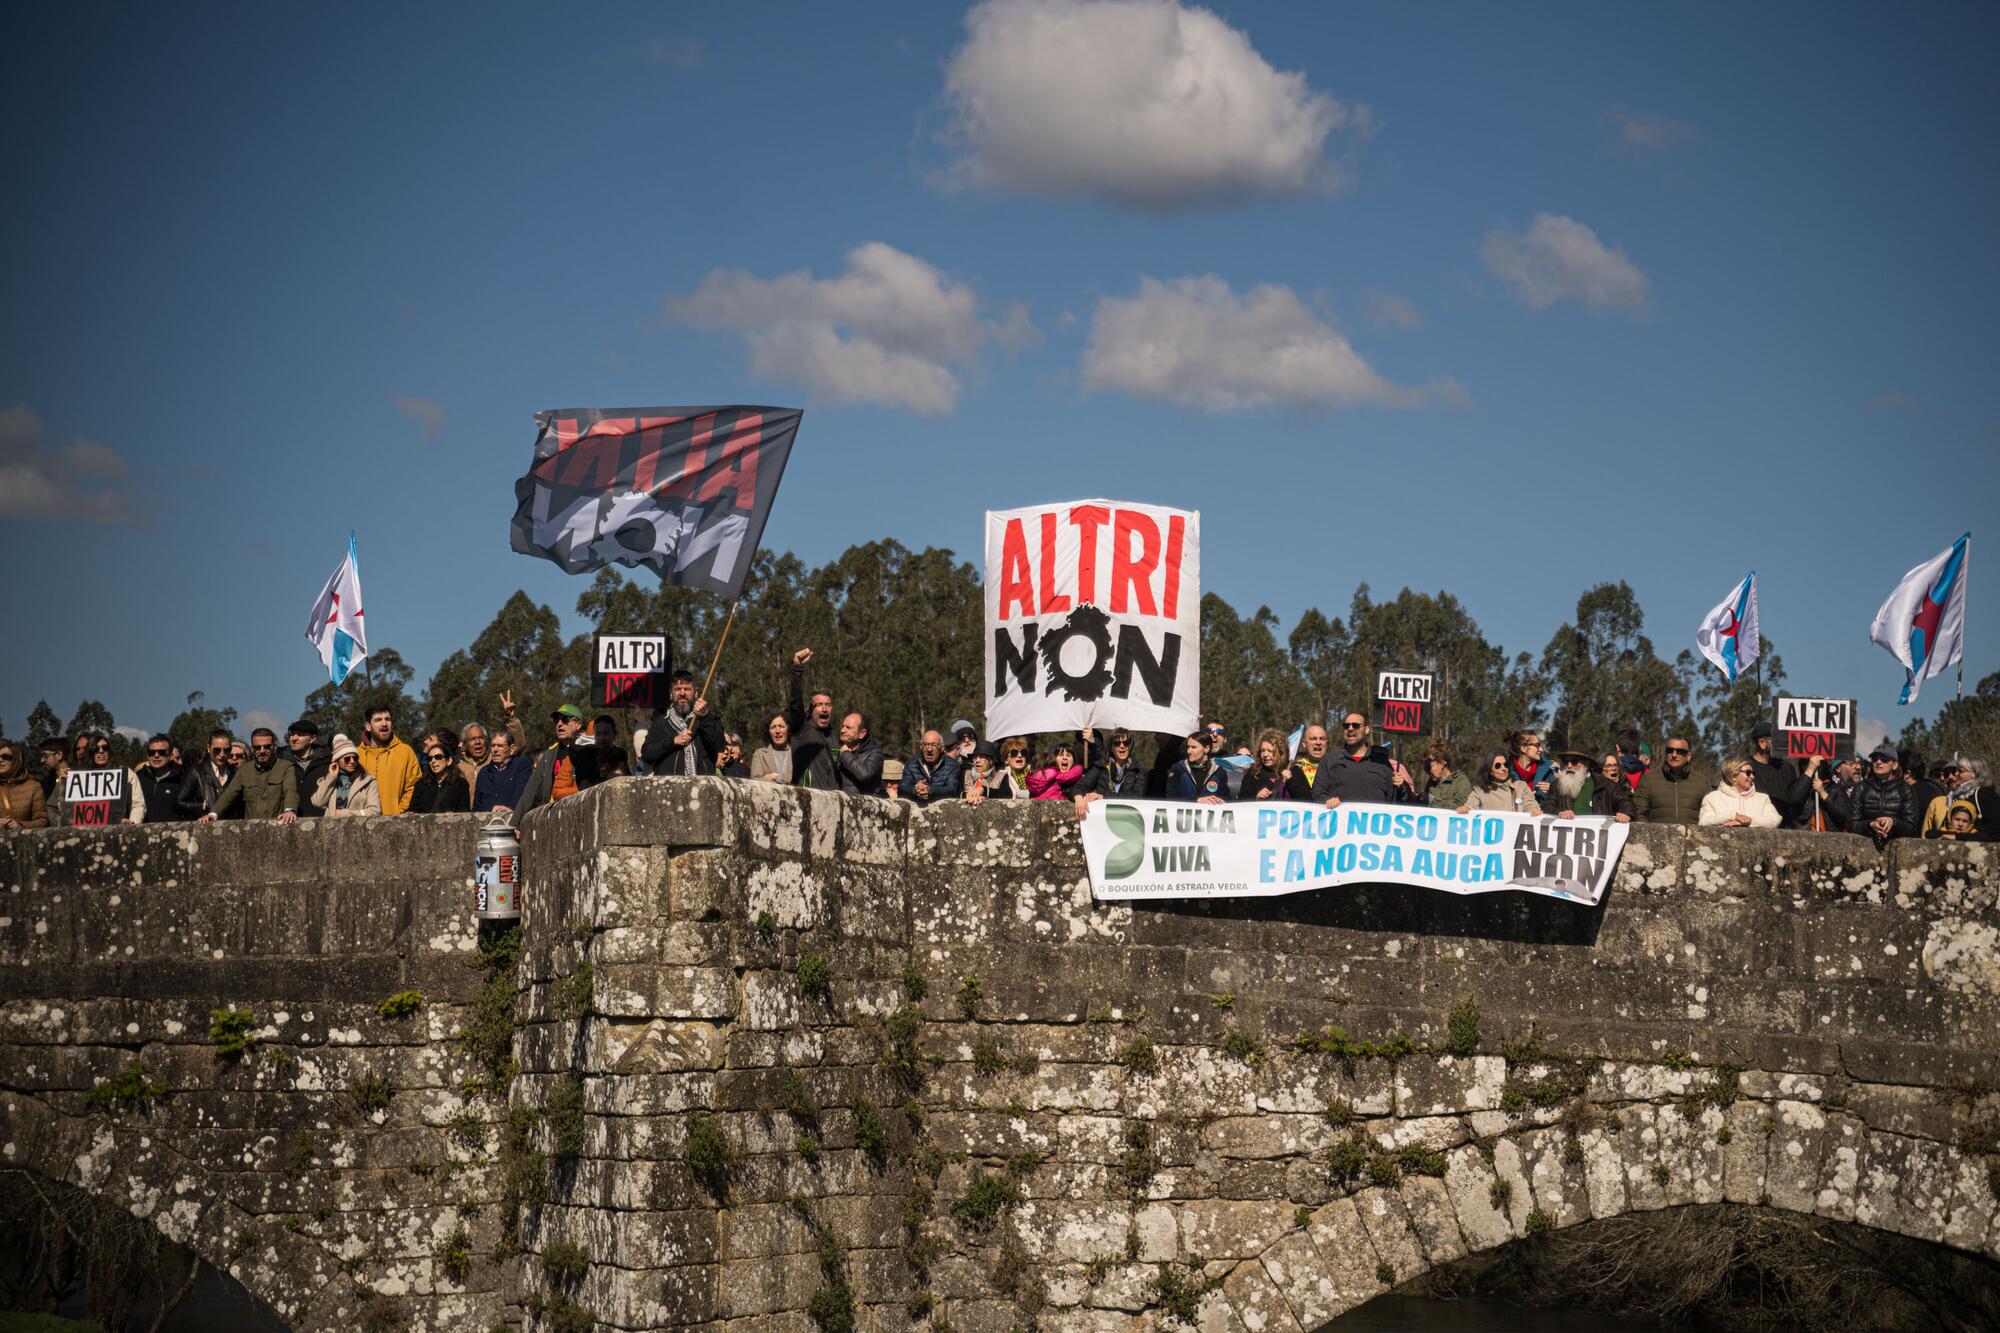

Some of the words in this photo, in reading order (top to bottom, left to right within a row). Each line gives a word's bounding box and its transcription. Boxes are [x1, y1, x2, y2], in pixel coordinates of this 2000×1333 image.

[999, 505, 1185, 620] ALTRI
[604, 641, 662, 669] ALTRI
[994, 604, 1182, 708] NON
[610, 677, 649, 703] NON
[1381, 676, 1429, 700] ALTRI
[1386, 705, 1418, 728] NON
[1785, 702, 1846, 729] ALTRI
[1791, 733, 1833, 757] NON
[68, 772, 120, 798] ALTRI
[75, 804, 106, 824] NON
[1152, 809, 1170, 833] A
[1176, 809, 1236, 834] ULLA
[1257, 809, 1338, 840] POLO
[1347, 811, 1438, 842] NOSO
[1447, 814, 1505, 846] RÍO
[1513, 824, 1609, 860] ALTRI
[500, 856, 512, 882] ALTRI
[1152, 846, 1211, 873] VIVA
[1259, 849, 1276, 883] E
[1284, 849, 1305, 882] A
[1314, 843, 1403, 878] NOSA
[1411, 848, 1504, 884] AUGA
[1512, 850, 1606, 893] NON
[478, 884, 486, 910] NON
[1167, 882, 1174, 891] A
[1176, 882, 1215, 891] ESTRADA
[1217, 882, 1248, 891] VEDRA
